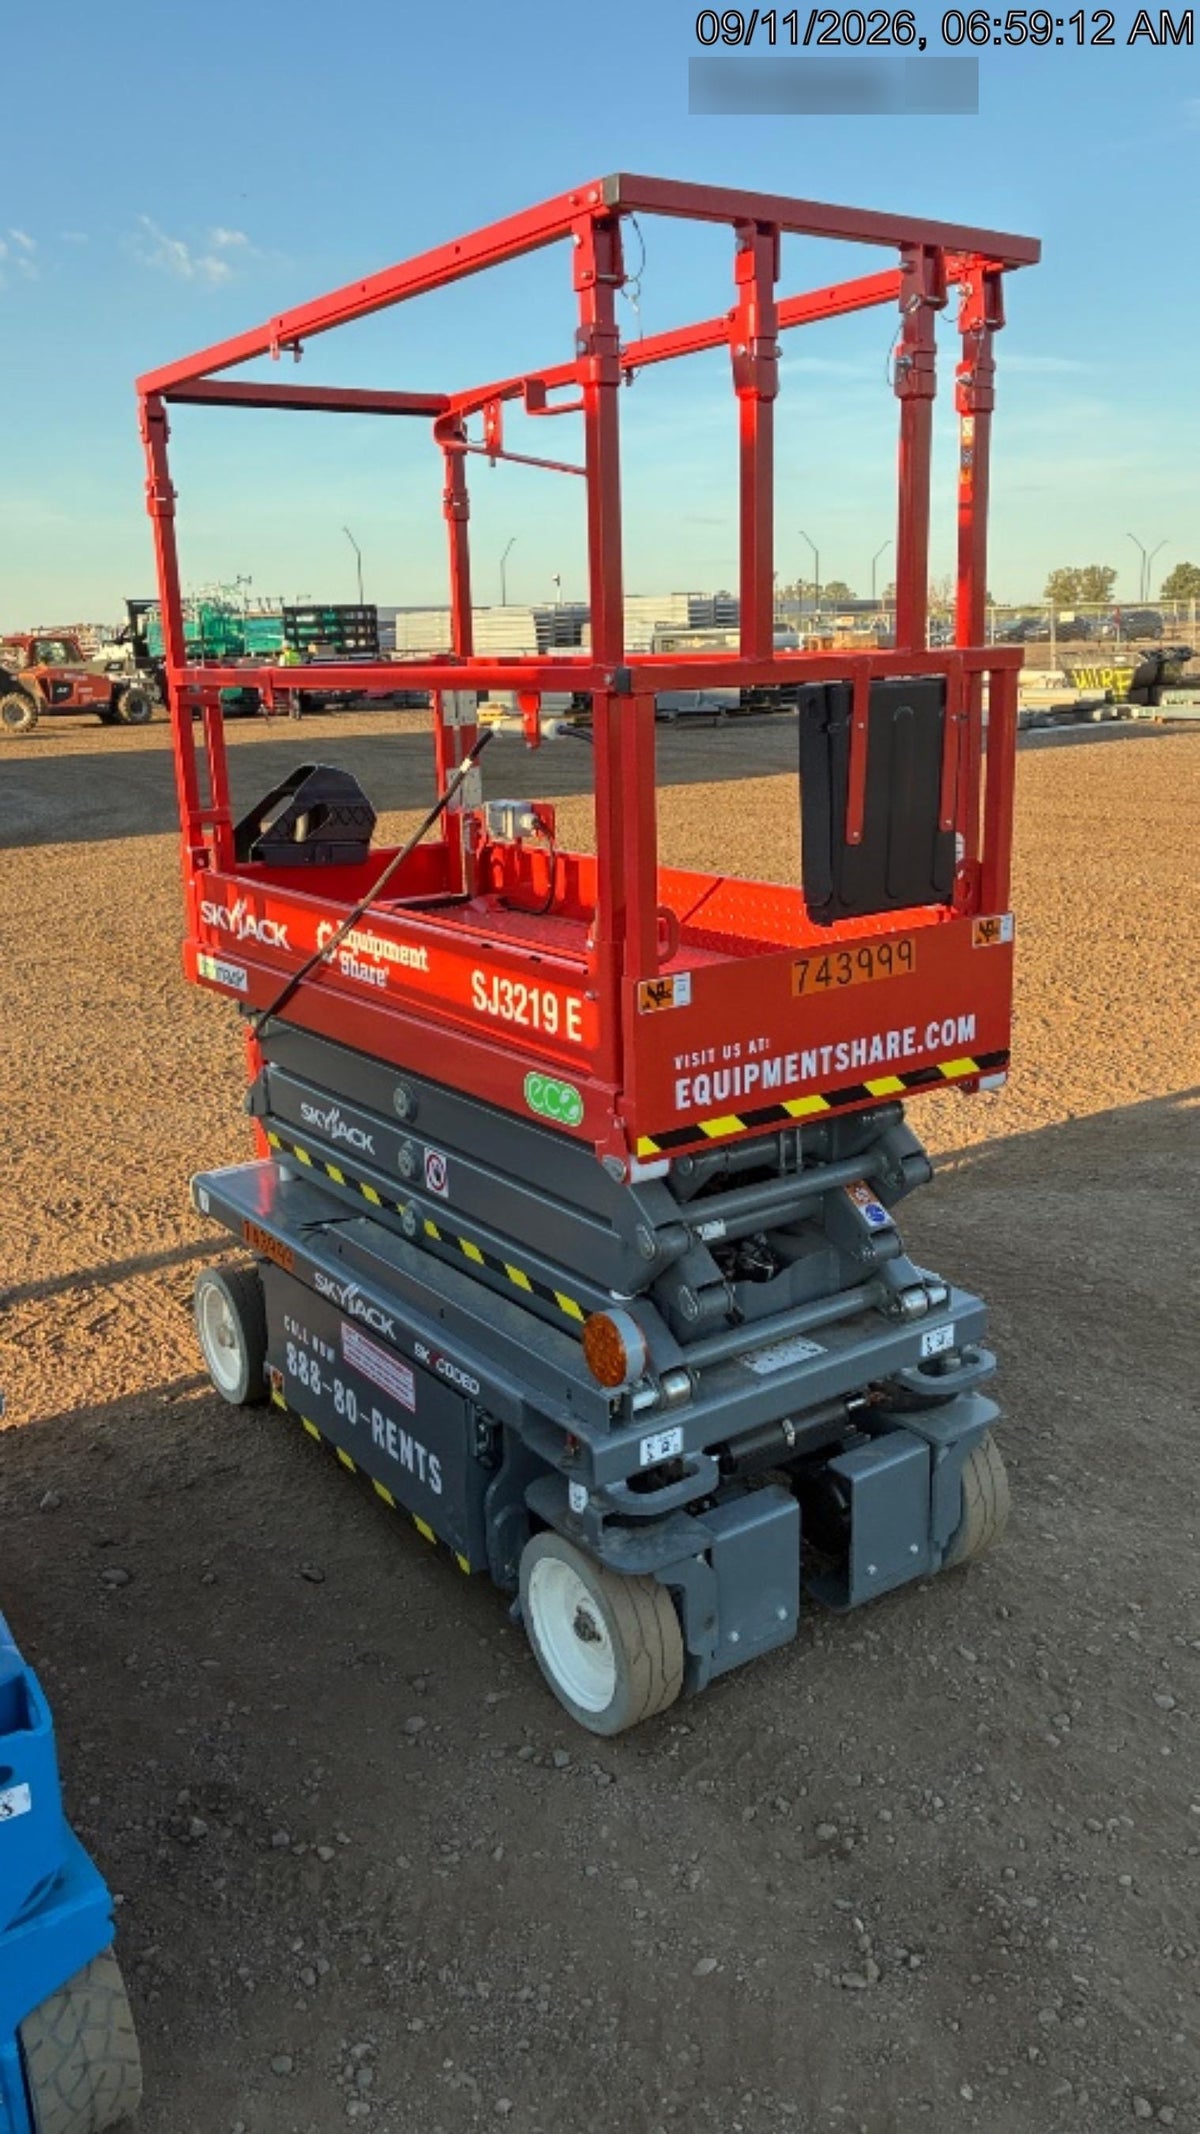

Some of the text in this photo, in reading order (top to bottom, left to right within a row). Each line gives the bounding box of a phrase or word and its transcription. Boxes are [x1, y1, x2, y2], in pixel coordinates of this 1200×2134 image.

[200, 898, 290, 950] SKYJACK
[794, 939, 913, 994] 743999
[471, 970, 582, 1042] SJ3219 E
[673, 1037, 770, 1071] VISIT US AT:
[674, 1013, 977, 1111] EQUIPMENTSHARE.COM
[300, 1100, 376, 1156] SKYJACK
[314, 1272, 397, 1341] SKYJACK
[286, 1341, 443, 1495] 888-80-RENTS
